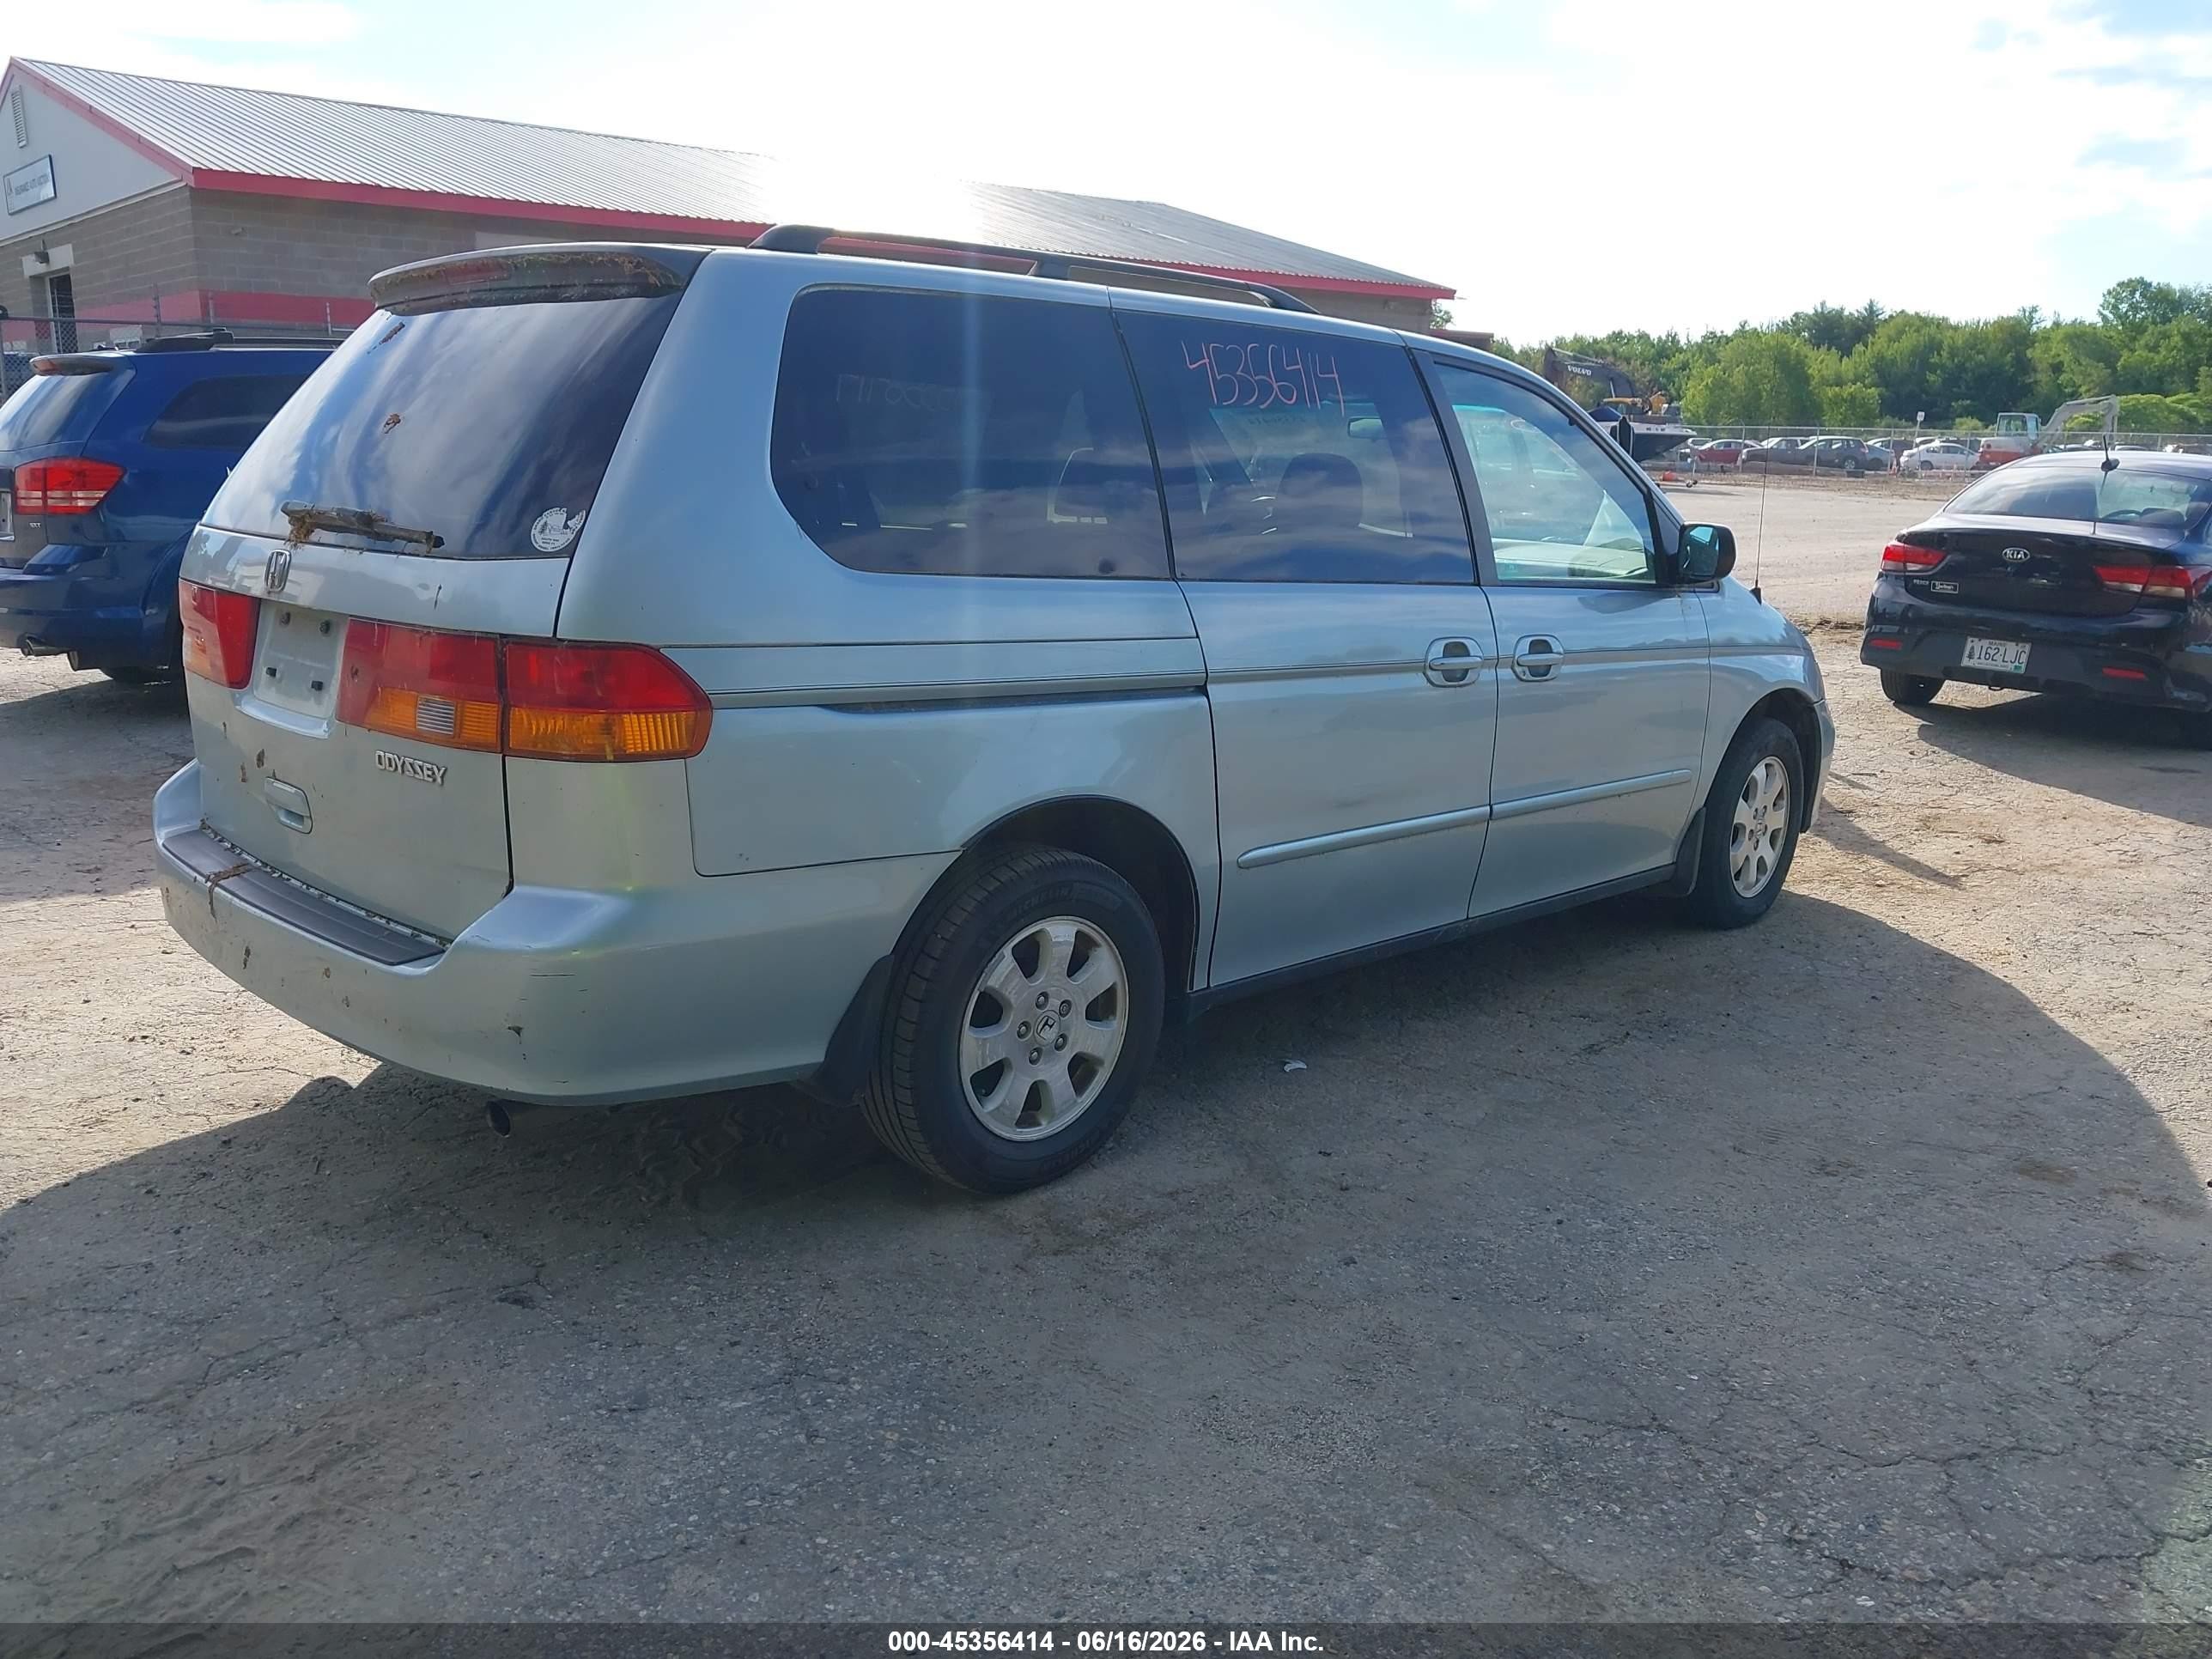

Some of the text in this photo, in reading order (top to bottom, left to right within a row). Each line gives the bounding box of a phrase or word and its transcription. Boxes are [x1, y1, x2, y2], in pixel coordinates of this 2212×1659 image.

[1182, 340, 1345, 417] 45356414
[1567, 365, 1592, 376] VOLVO
[2005, 549, 2027, 560] KIA
[375, 750, 447, 785] ODYSSEY
